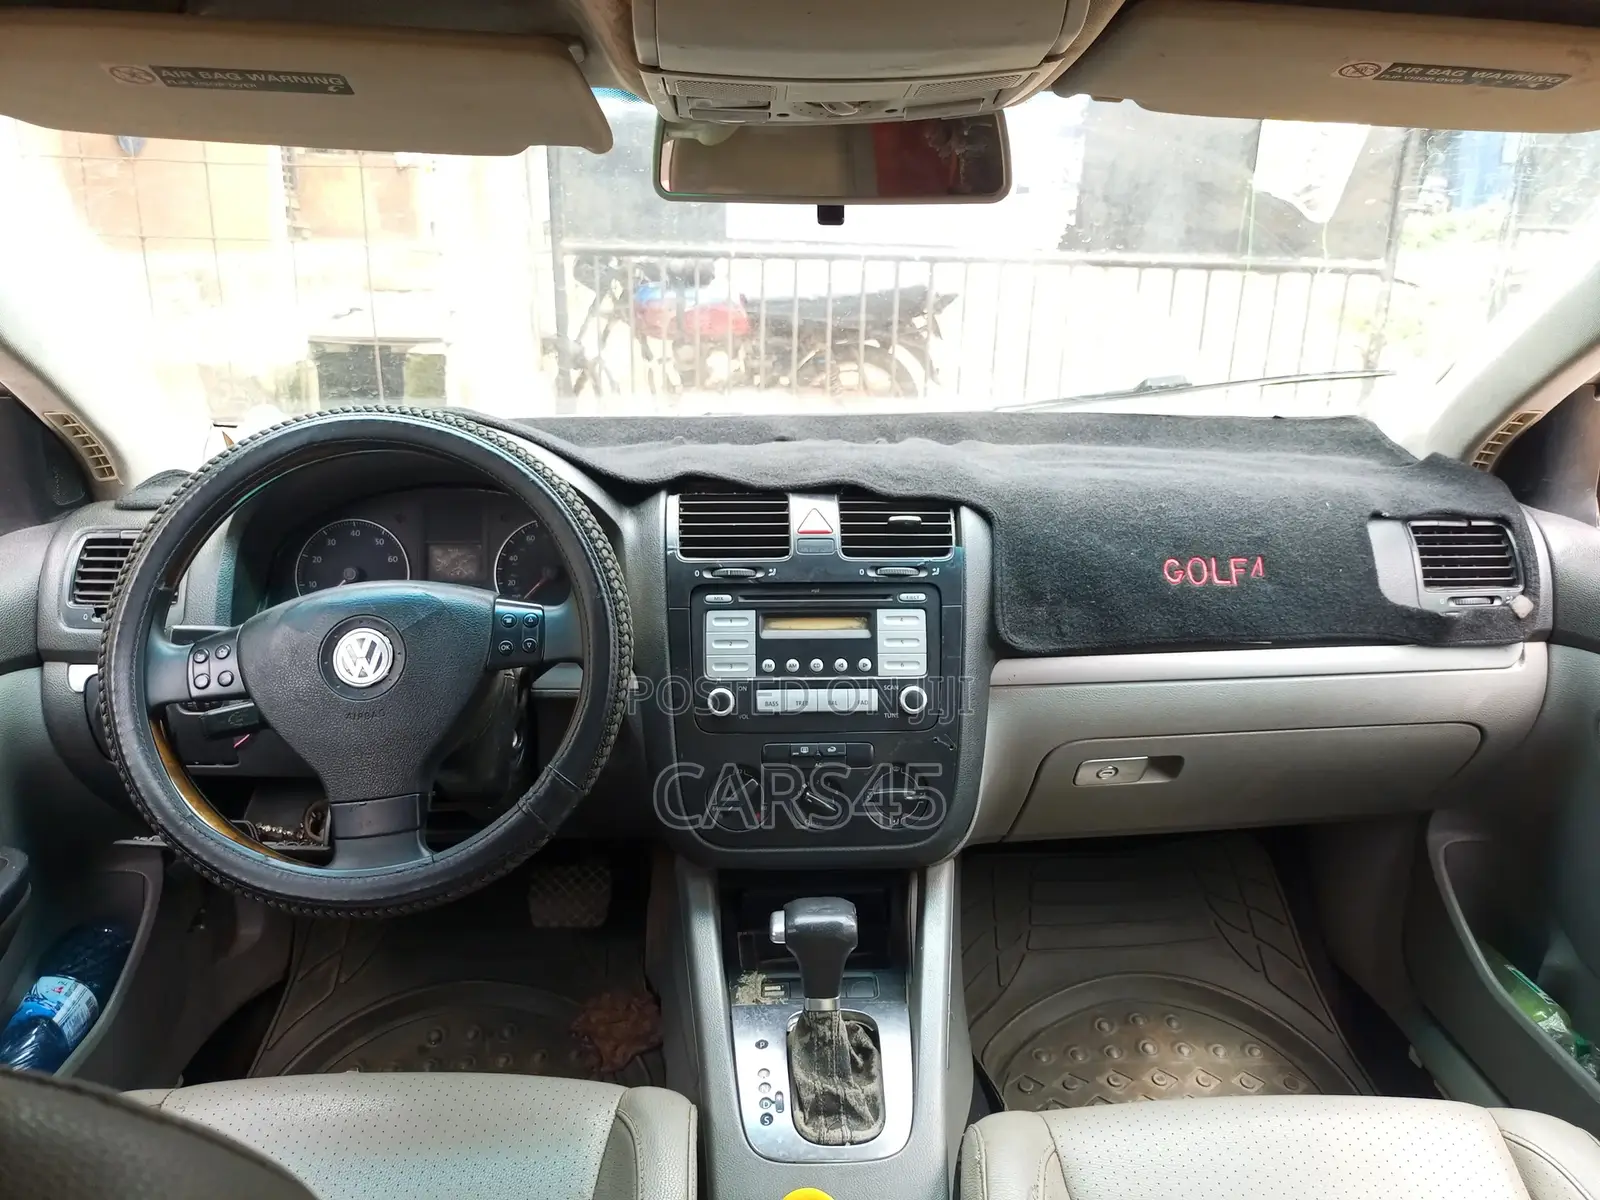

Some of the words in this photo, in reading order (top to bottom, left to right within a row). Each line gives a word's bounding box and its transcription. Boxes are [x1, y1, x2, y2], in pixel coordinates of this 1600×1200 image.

[160, 68, 194, 79] AIR
[198, 70, 242, 81] BAG
[246, 73, 345, 86] WARNING
[1389, 65, 1422, 75] AIR
[1425, 67, 1467, 78] BAG
[1471, 70, 1562, 84] WARNING
[327, 538, 336, 546] 30
[375, 538, 385, 546] 50
[312, 556, 322, 564] 20
[308, 580, 317, 588] 10
[344, 709, 387, 720] AIRBAG
